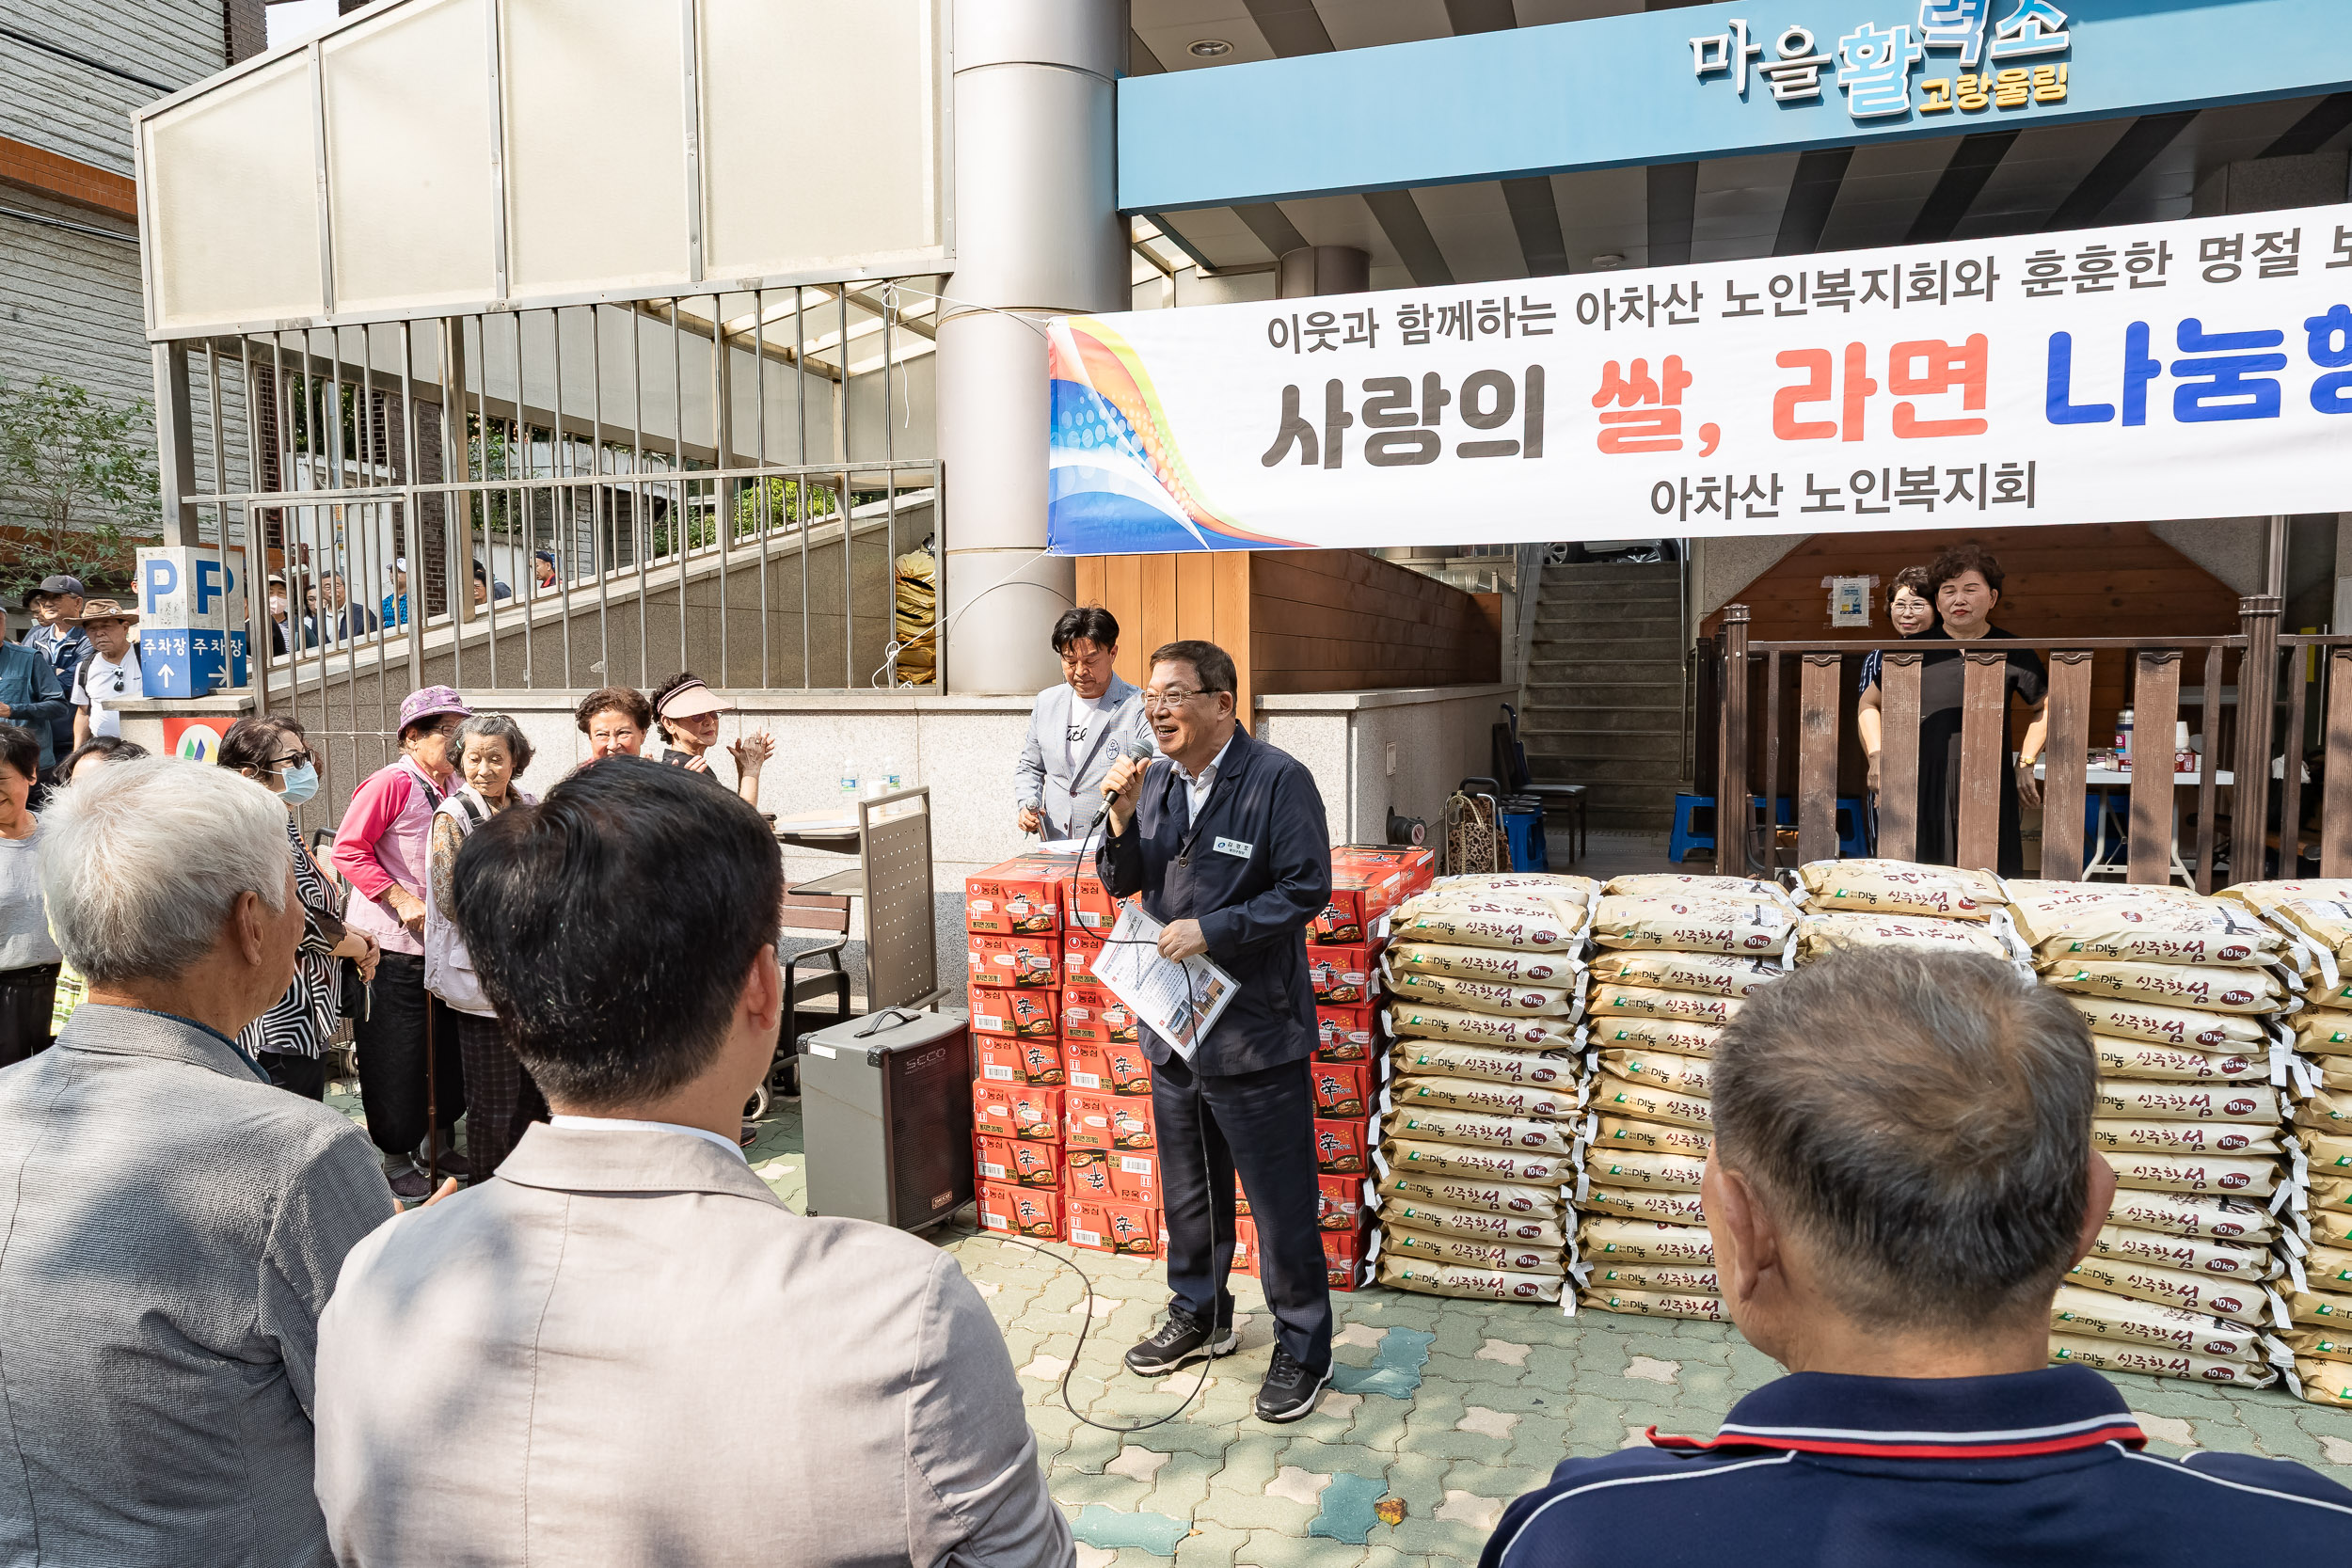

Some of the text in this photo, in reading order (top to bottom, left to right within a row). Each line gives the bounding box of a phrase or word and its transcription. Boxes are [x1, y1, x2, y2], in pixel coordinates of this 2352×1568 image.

[1919, 63, 2068, 112] 고랑울림
[1268, 308, 1378, 354] 이웃과
[1396, 294, 1557, 345] 함께하는
[1576, 285, 1704, 331] 아차산
[1723, 256, 2000, 318] 노인복지회와
[2022, 240, 2172, 295] 훈훈한
[2200, 227, 2301, 283] 명절
[1262, 364, 1544, 469] 사랑의
[1592, 354, 1722, 457] 쌀,
[1772, 333, 1989, 441] 라면
[1651, 460, 2038, 522] 아차산 노인복지회
[146, 560, 177, 614] P
[196, 560, 233, 614] P
[143, 638, 186, 657] 주차장
[193, 639, 243, 657] 주차장
[1535, 930, 1555, 941] 10kg
[1747, 938, 1768, 947] 10kg
[2222, 948, 2247, 958] 10kg
[1531, 968, 1550, 977] 10kg
[1524, 996, 1543, 1006] 10kg
[2226, 991, 2250, 1003] 10kg
[1535, 1070, 1553, 1080] 10kg
[2229, 1103, 2252, 1112] 10kg
[1525, 1135, 1544, 1144] 10kg
[1527, 1168, 1545, 1177] 10kg
[2223, 1177, 2247, 1185] 10kg
[1512, 1200, 1530, 1210] 10kg
[1520, 1227, 1538, 1237] 10kg
[2217, 1226, 2240, 1235] 10kg
[1519, 1257, 1537, 1265] 10kg
[2211, 1261, 2234, 1271] 10kg
[1518, 1286, 1536, 1294] 10kg
[2215, 1299, 2239, 1311] 10kg
[2210, 1342, 2233, 1353] 10kg
[2207, 1370, 2232, 1379] 10kg
